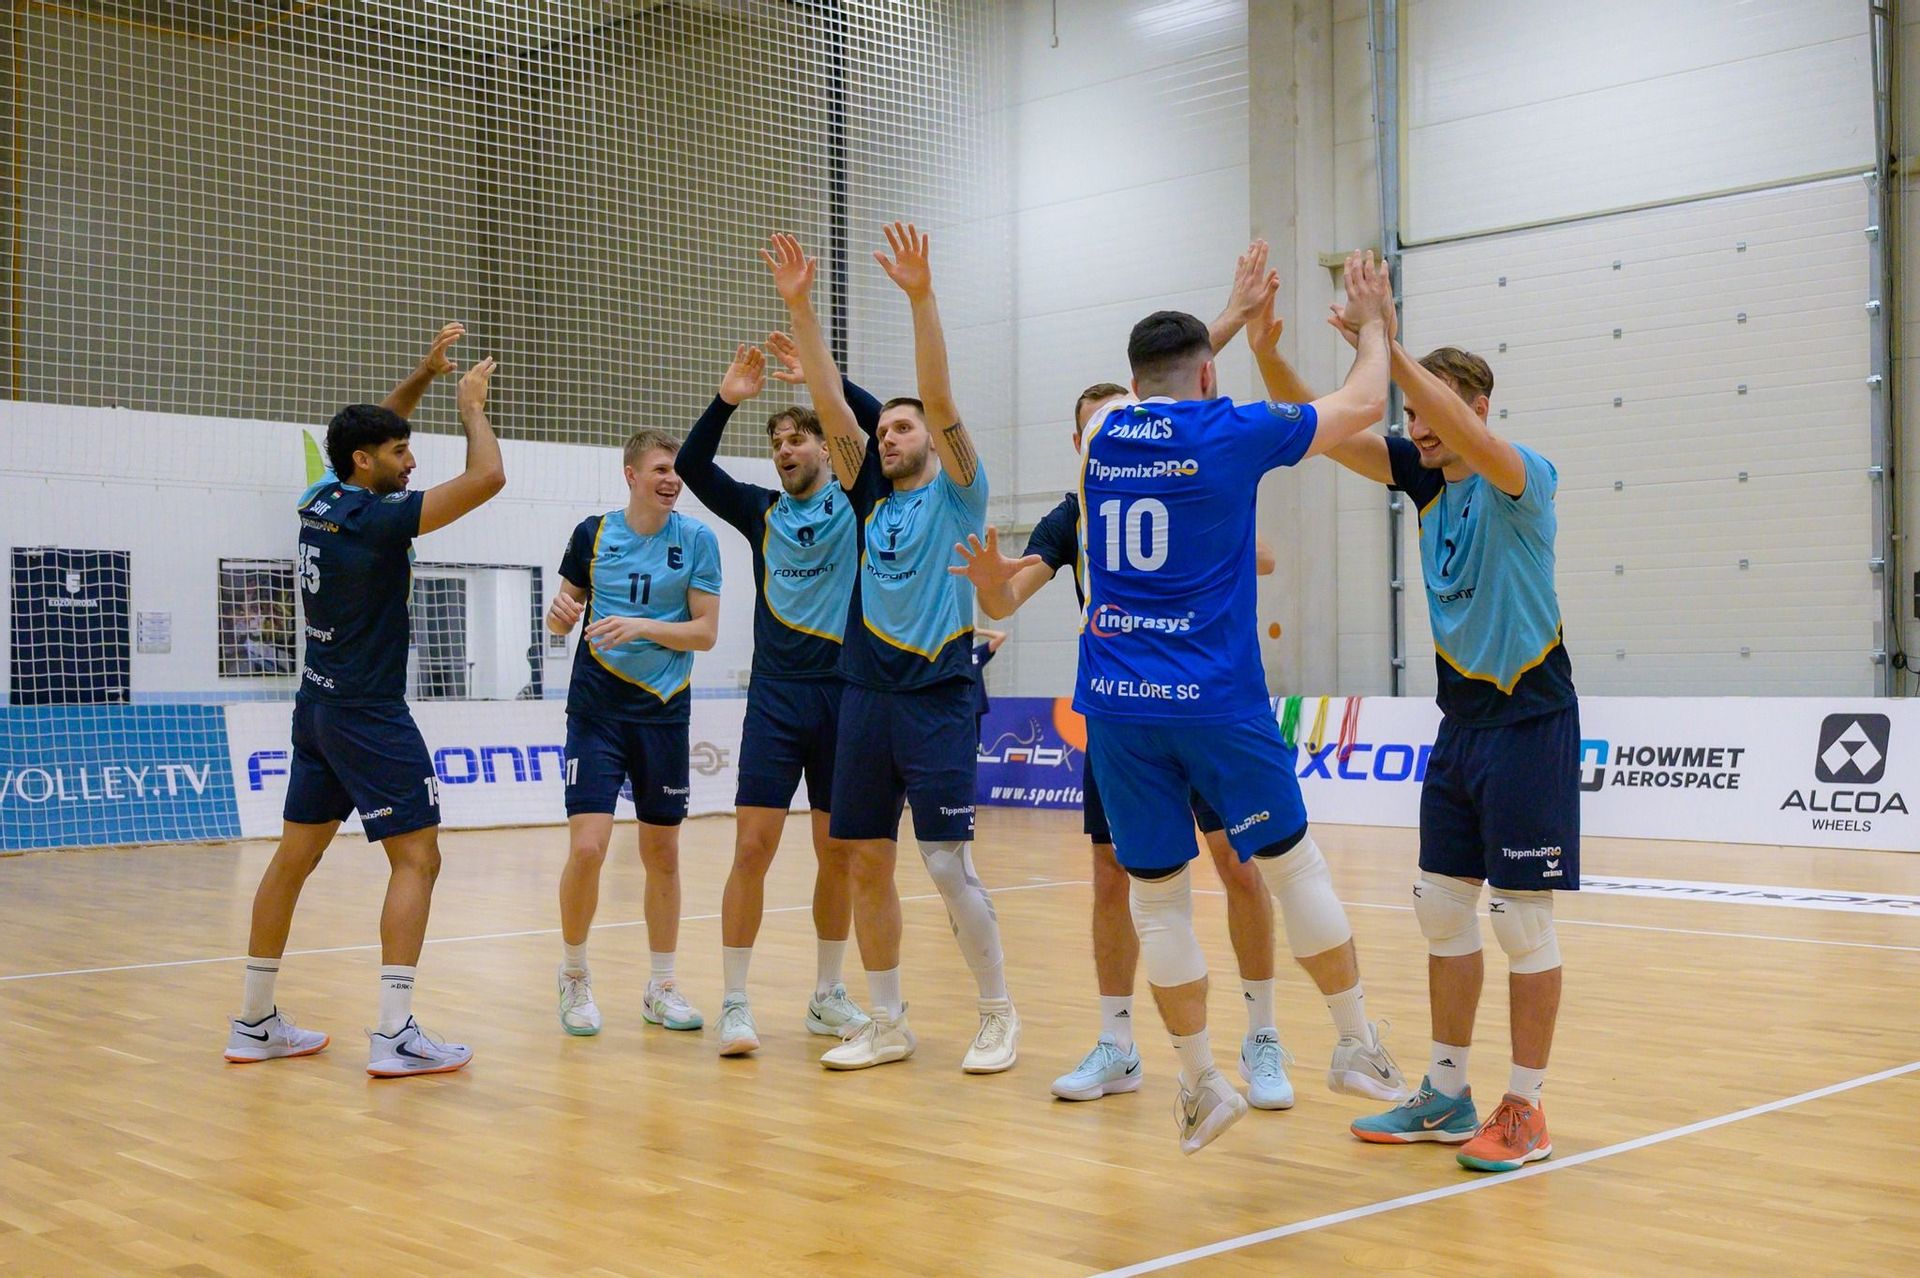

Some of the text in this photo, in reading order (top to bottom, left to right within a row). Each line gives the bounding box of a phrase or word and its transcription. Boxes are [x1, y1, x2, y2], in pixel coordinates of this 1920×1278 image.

[1089, 458, 1199, 481] TippmixPRO
[1099, 497, 1169, 572] 10
[628, 572, 652, 605] 11
[1099, 604, 1191, 634] ingrasys
[1176, 684, 1200, 700] SC
[1614, 745, 1745, 769] HOWMET
[565, 758, 579, 786] 11
[1611, 770, 1741, 790] AEROSPACE
[1779, 789, 1909, 815] ALCOA
[1811, 818, 1872, 833] WHEELS
[1501, 846, 1562, 860] TippmixPRO
